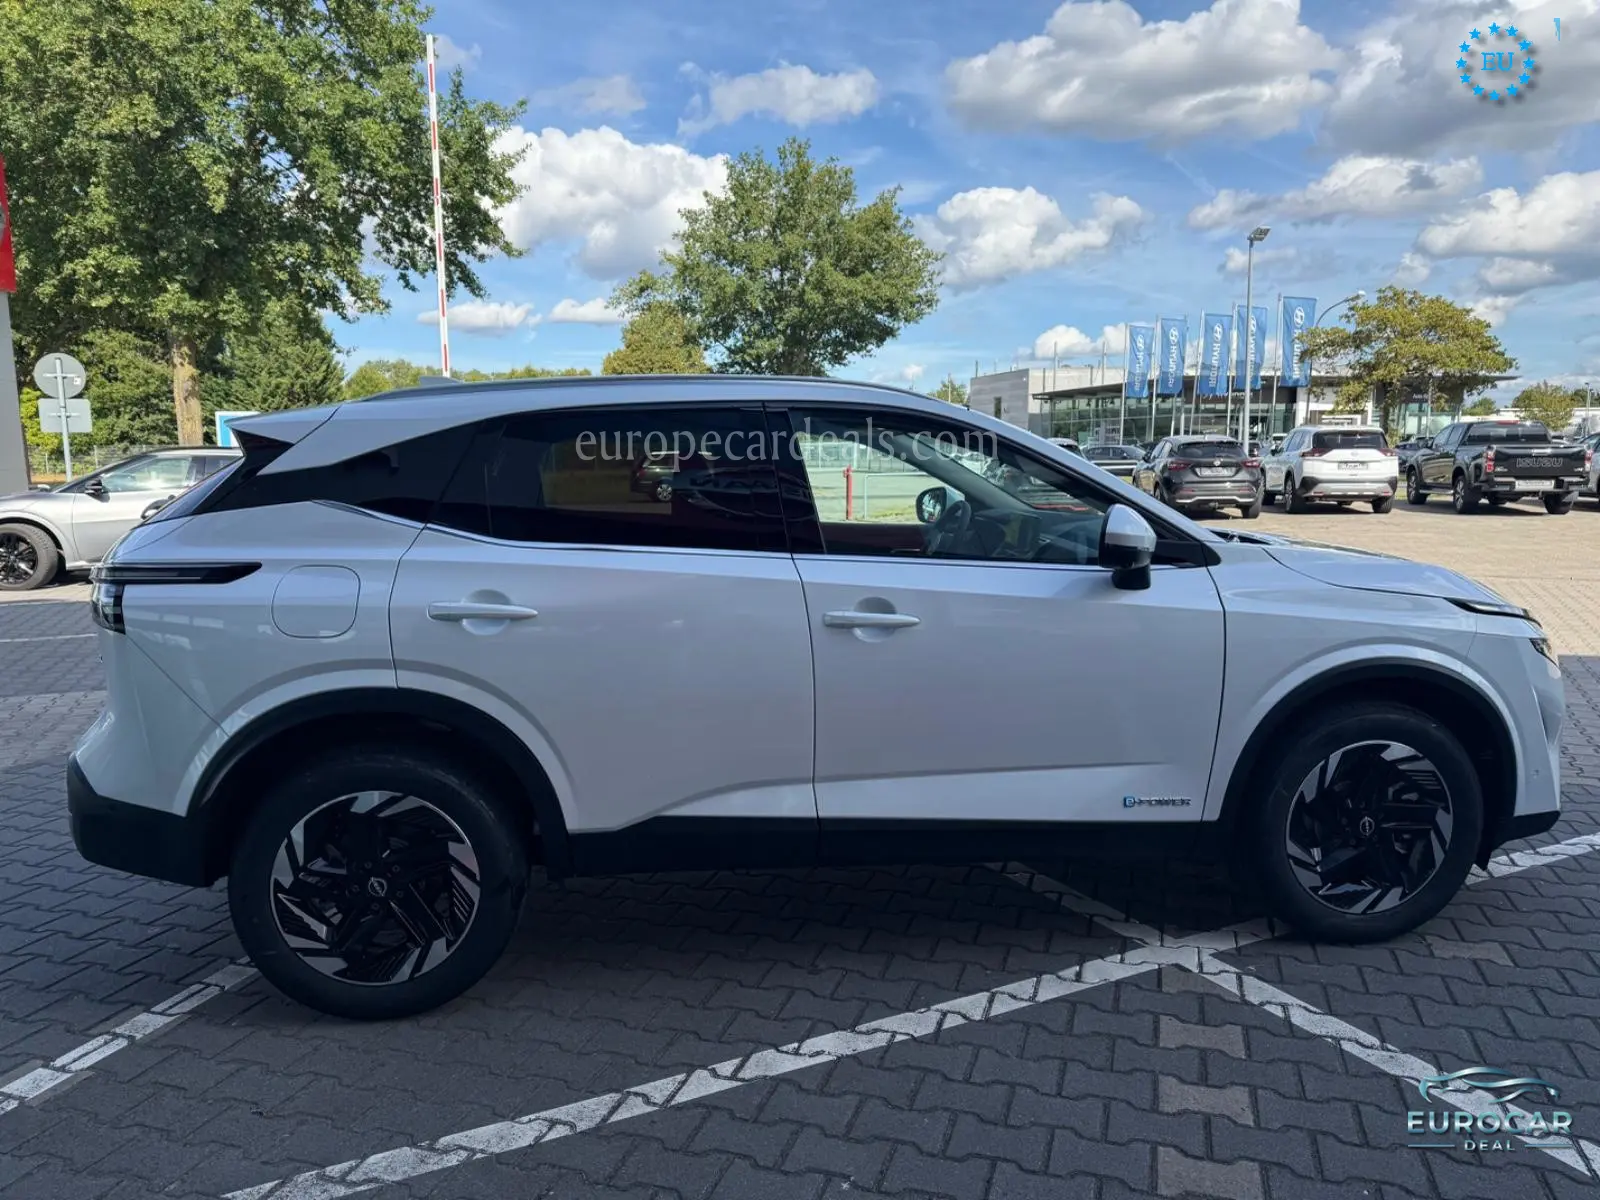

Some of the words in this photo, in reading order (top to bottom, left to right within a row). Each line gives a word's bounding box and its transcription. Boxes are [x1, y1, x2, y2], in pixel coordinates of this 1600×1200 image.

[1168, 345, 1178, 388] HYUNDAI
[1208, 343, 1221, 388] HYUNDAI
[1516, 457, 1563, 468] ISUZU
